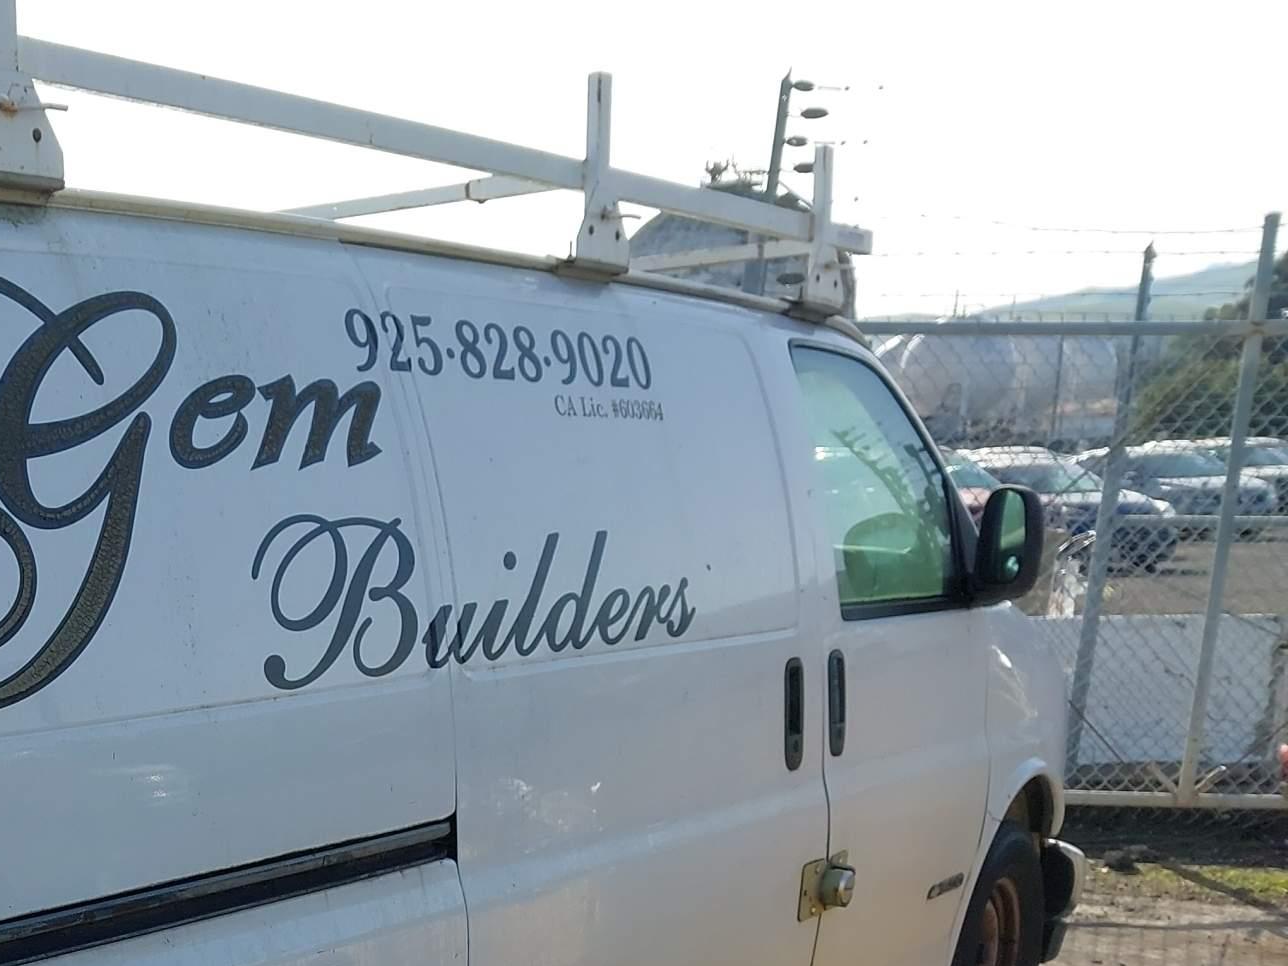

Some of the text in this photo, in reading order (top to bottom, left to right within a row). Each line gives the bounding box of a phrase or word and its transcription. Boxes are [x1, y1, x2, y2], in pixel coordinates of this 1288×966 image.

[554, 394, 664, 421] CA Lic. #603664
[251, 514, 696, 690] Builders
